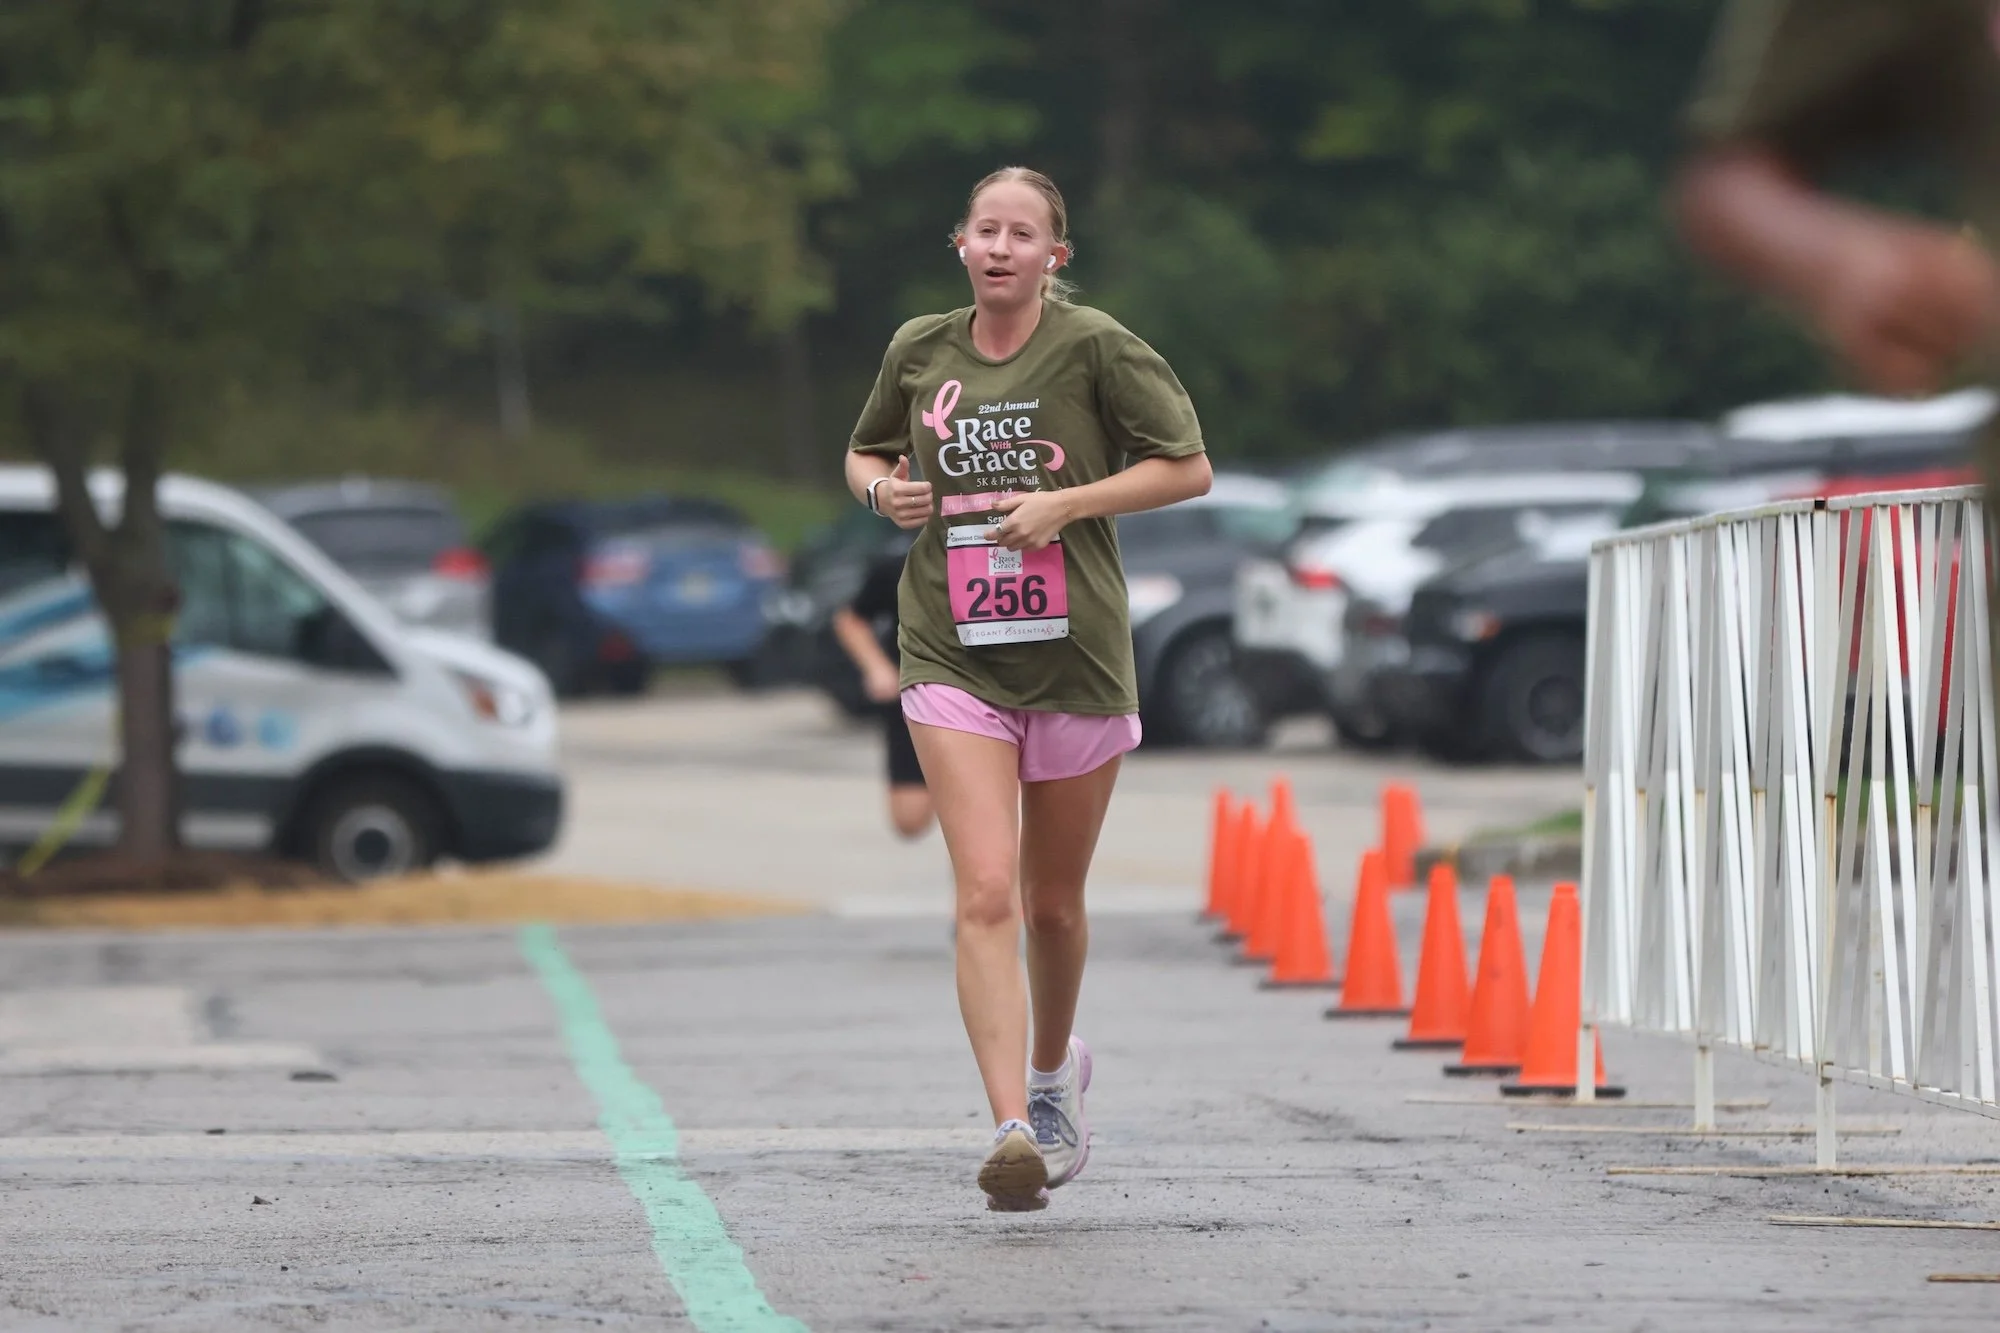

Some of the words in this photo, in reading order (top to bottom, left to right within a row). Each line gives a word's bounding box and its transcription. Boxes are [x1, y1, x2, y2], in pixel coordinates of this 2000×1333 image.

[978, 402, 1001, 414] 22nd
[1003, 398, 1040, 411] Annual
[955, 416, 1032, 454] Race
[990, 440, 1012, 450] With
[938, 442, 1037, 477] Grace
[977, 477, 989, 488] 5K
[991, 477, 998, 485] &
[1000, 475, 1018, 485] Fun
[1019, 475, 1040, 486] Walk
[993, 561, 1016, 570] Grace
[998, 556, 1016, 564] Race
[966, 575, 1048, 618] 256
